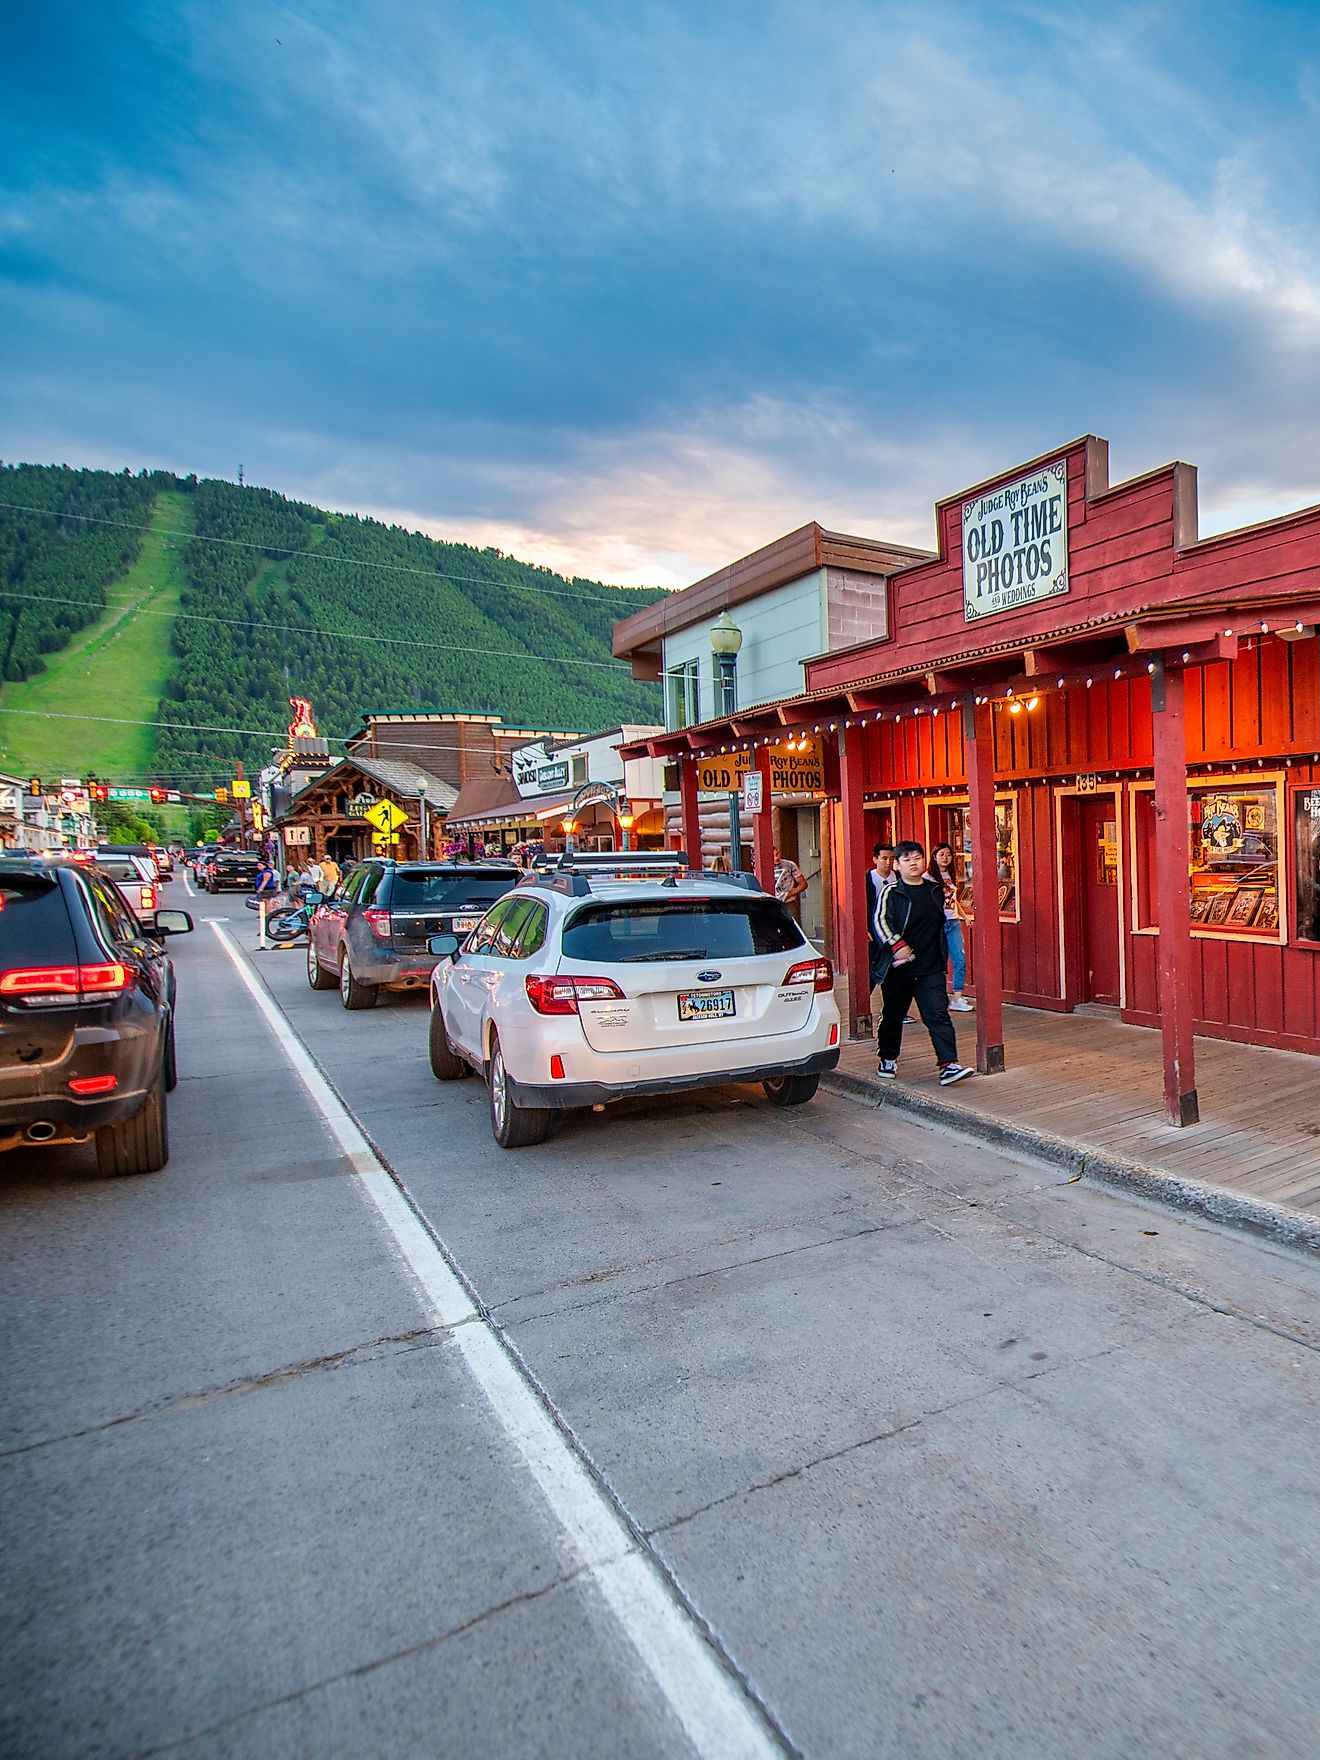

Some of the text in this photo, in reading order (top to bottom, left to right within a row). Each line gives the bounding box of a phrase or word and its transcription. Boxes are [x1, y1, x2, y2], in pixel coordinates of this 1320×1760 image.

[977, 494, 1004, 521] JUDGE
[1004, 488, 1021, 511] ROY
[967, 494, 1062, 562] OLD TIME
[976, 538, 1053, 598] PHOTOS
[1001, 582, 1036, 606] WEDDINGS
[770, 755, 788, 769] ROY
[703, 769, 731, 788] OLD
[773, 770, 822, 788] PHOTOS
[700, 998, 731, 1013] 26917
